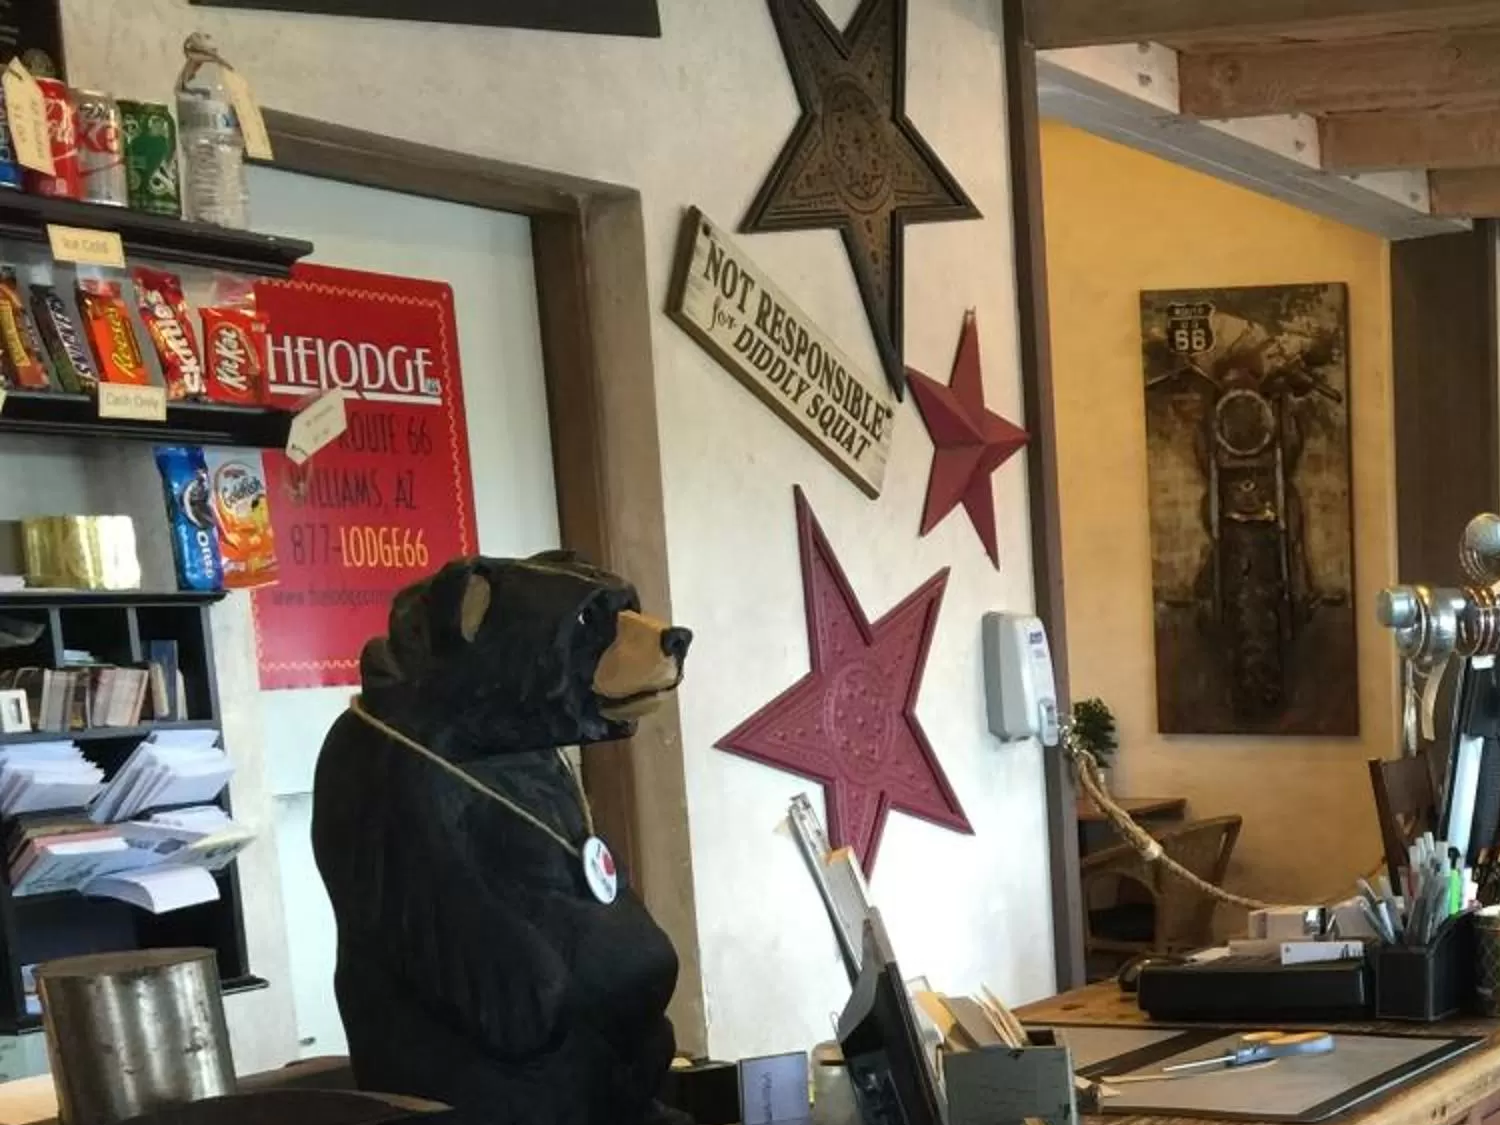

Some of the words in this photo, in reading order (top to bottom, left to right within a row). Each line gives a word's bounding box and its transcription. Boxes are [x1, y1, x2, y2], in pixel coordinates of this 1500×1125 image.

[703, 240, 755, 314] NOT
[755, 289, 887, 442] RESPONSIBLE
[1175, 329, 1206, 351] 66
[267, 333, 433, 397] HELODGE
[707, 295, 738, 332] for
[733, 324, 810, 405] DIDDLY
[805, 393, 872, 461] SQUAT
[407, 414, 433, 457] 66
[395, 469, 416, 511] AZ
[290, 523, 430, 569] 877-LODGE66
